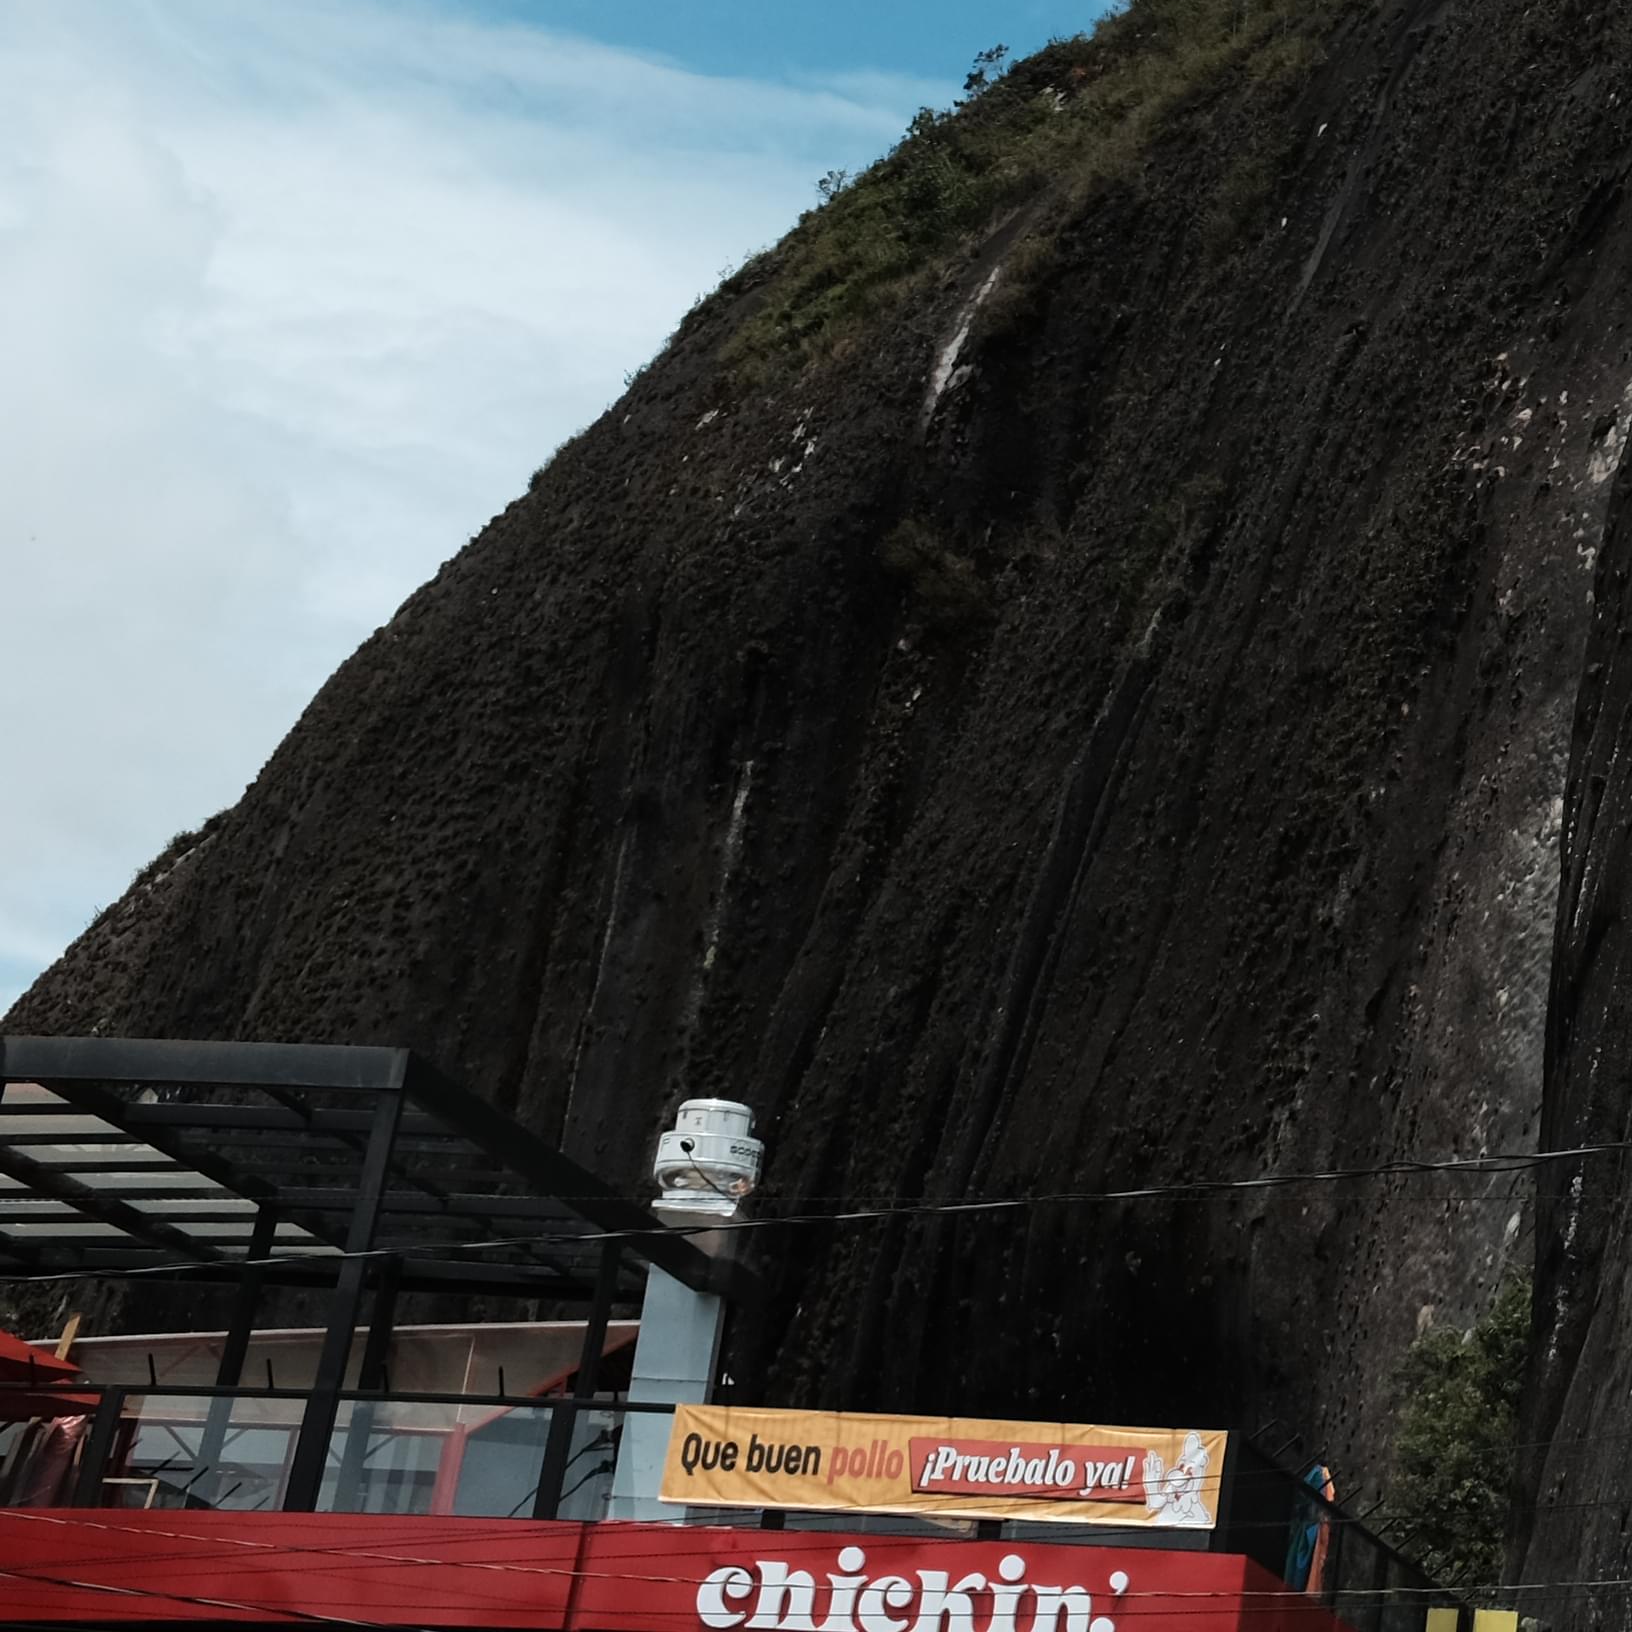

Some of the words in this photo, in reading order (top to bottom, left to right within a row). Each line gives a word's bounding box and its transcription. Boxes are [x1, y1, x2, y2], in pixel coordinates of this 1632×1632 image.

[682, 1432, 739, 1473] Que
[745, 1434, 821, 1476] buen
[826, 1439, 904, 1484] pollo
[920, 1446, 1076, 1488] ¡Pruebalo
[1079, 1455, 1136, 1495] ya!
